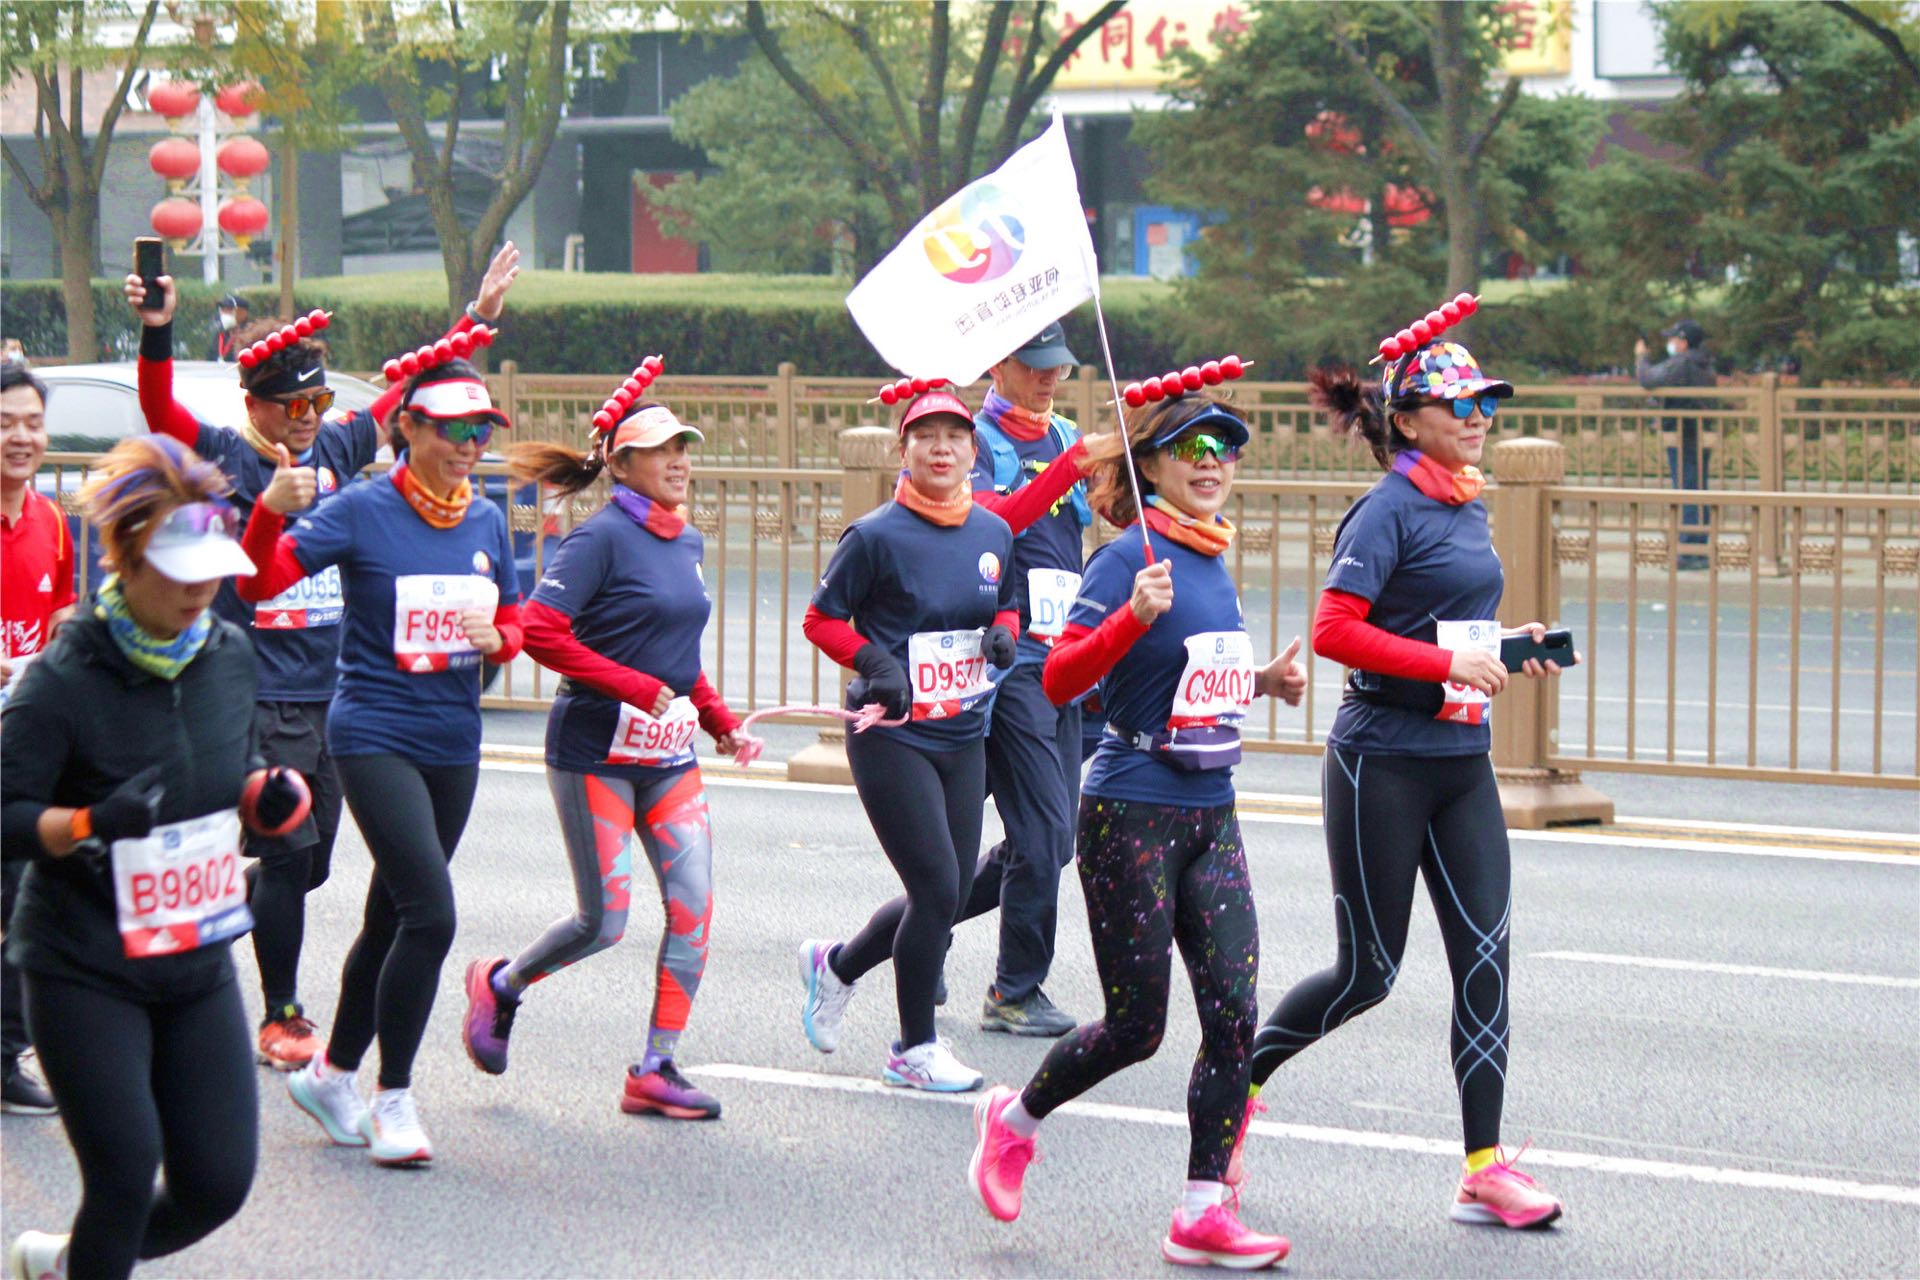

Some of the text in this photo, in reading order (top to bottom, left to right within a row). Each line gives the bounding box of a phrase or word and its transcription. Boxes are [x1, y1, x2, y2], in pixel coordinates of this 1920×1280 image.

[918, 655, 985, 692] D9577
[1185, 667, 1252, 706] C9402
[623, 716, 696, 752] E9817
[131, 853, 236, 918] B9802
